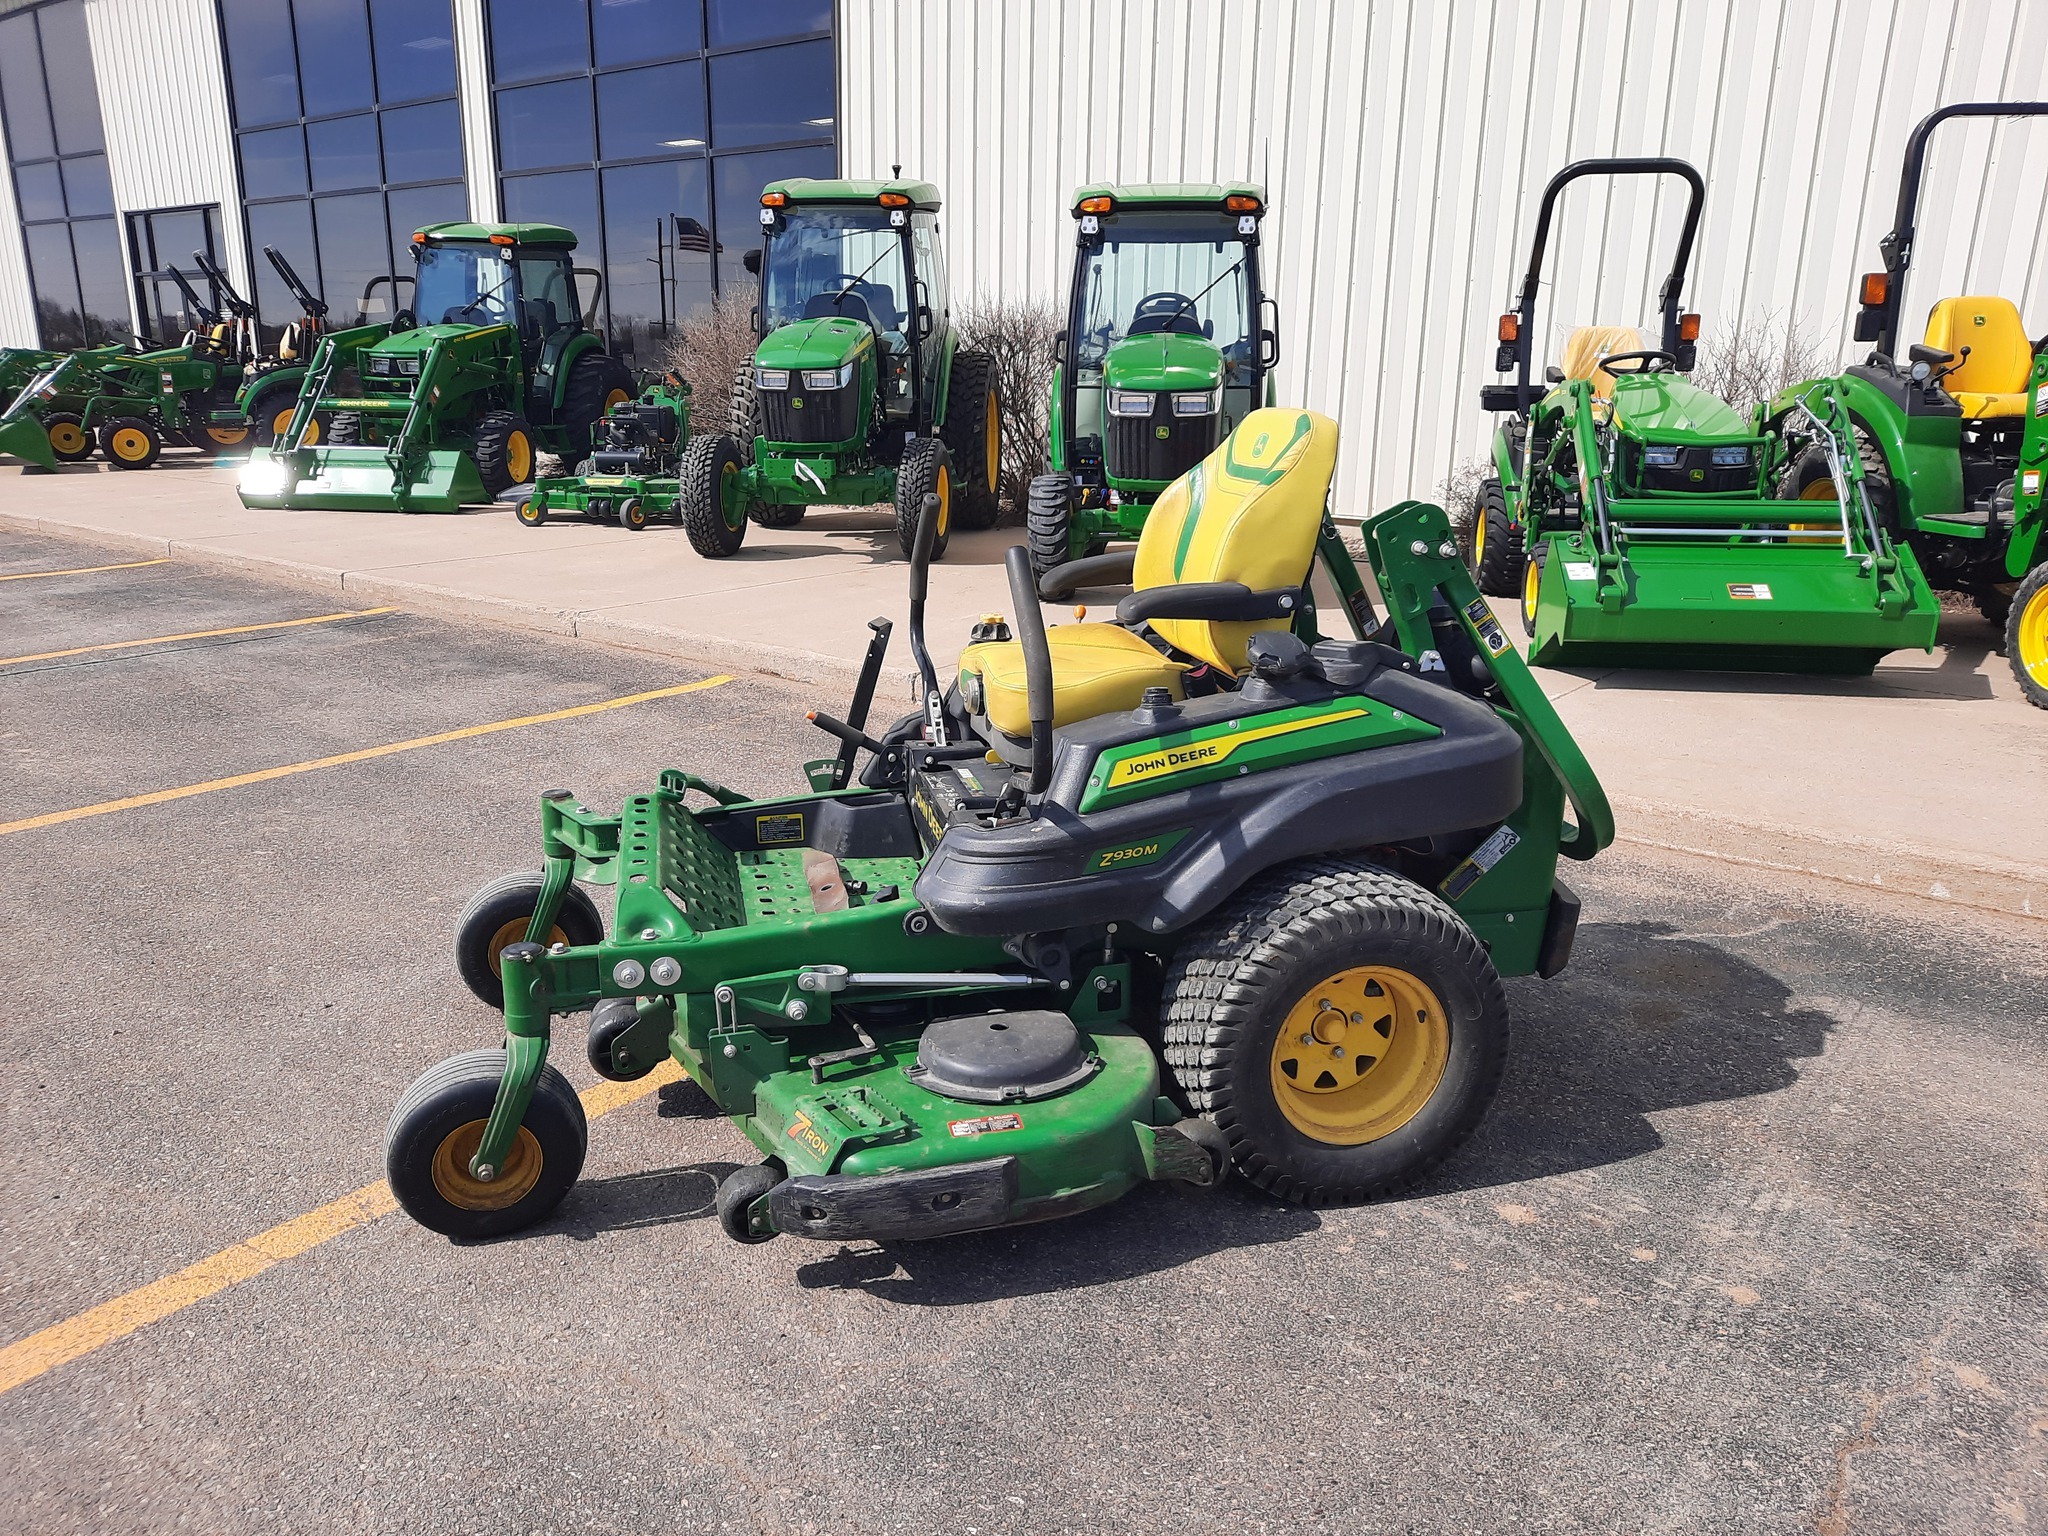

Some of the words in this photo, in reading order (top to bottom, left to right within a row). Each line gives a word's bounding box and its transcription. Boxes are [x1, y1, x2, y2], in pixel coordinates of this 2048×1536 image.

[1126, 758, 1166, 776] JOHN
[1168, 746, 1218, 766] DEERE
[1099, 844, 1159, 867] Z930M
